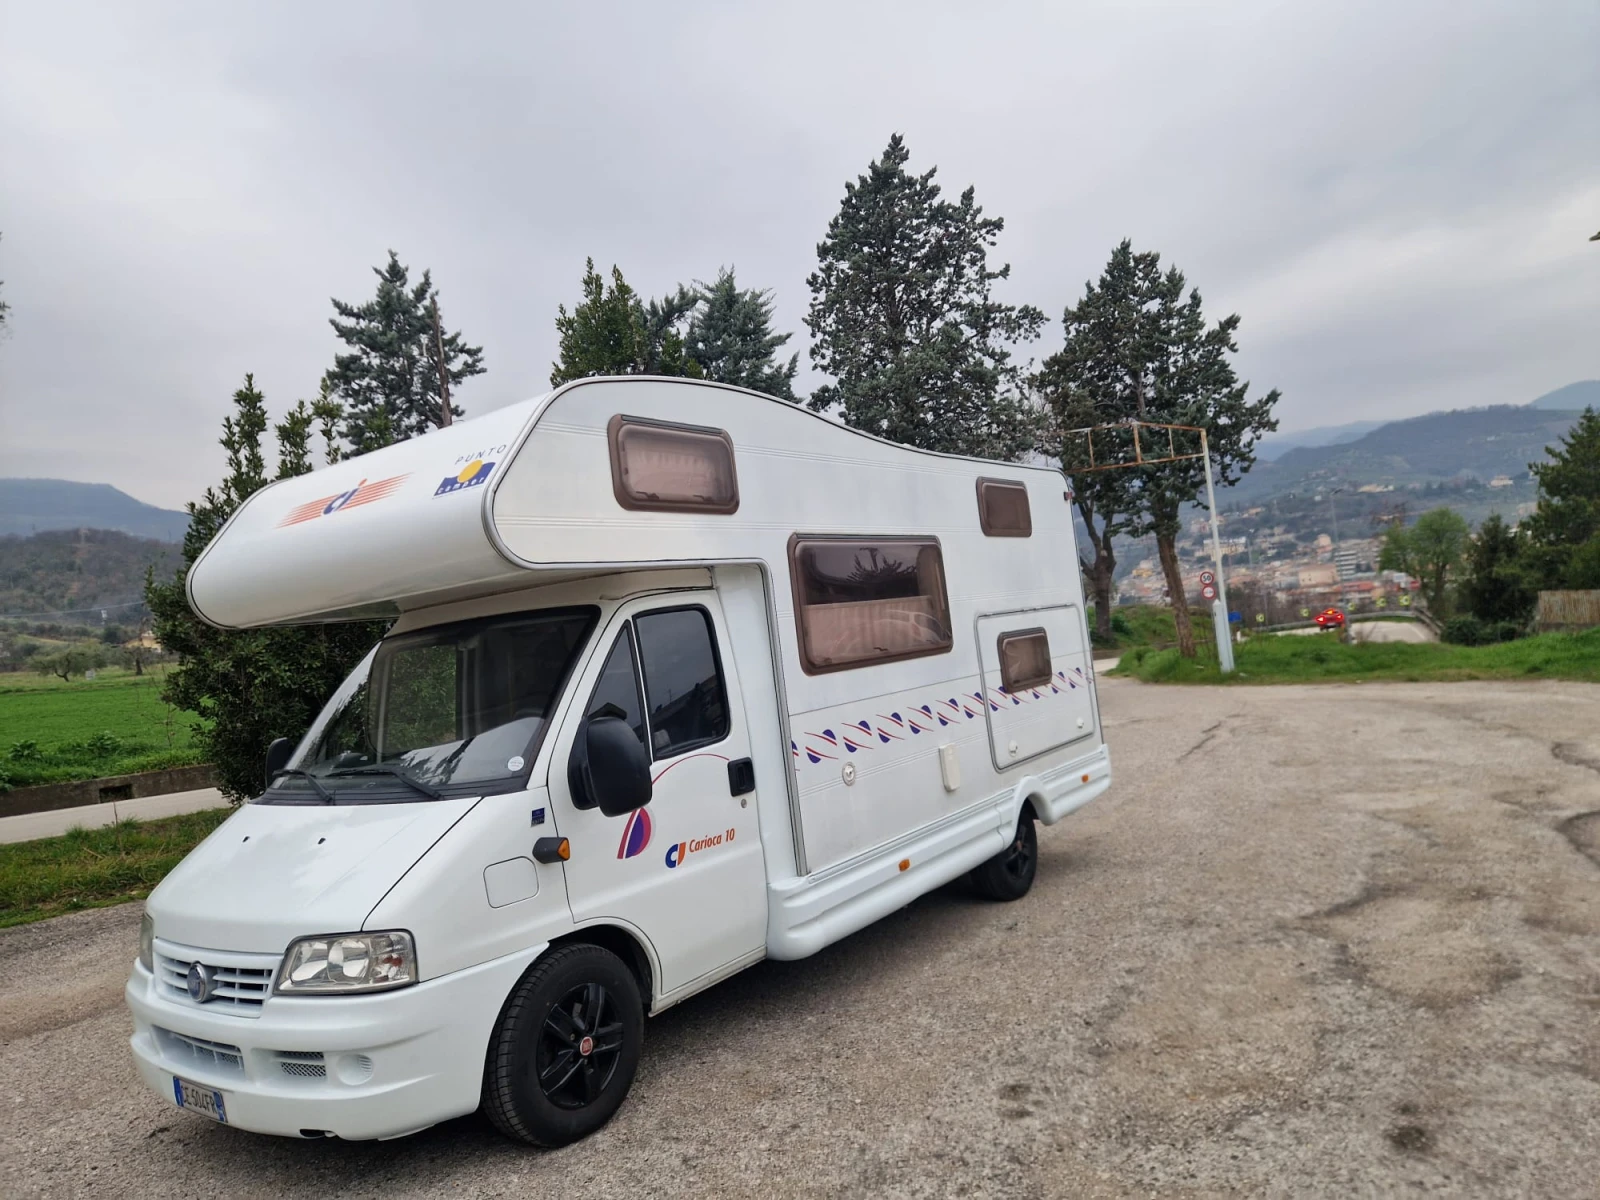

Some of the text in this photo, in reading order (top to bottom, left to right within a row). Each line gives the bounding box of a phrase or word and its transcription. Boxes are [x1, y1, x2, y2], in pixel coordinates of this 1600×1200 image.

[454, 444, 506, 465] PUNTO
[1202, 574, 1211, 582] 50
[689, 835, 722, 852] Carioca
[725, 828, 735, 842] 10
